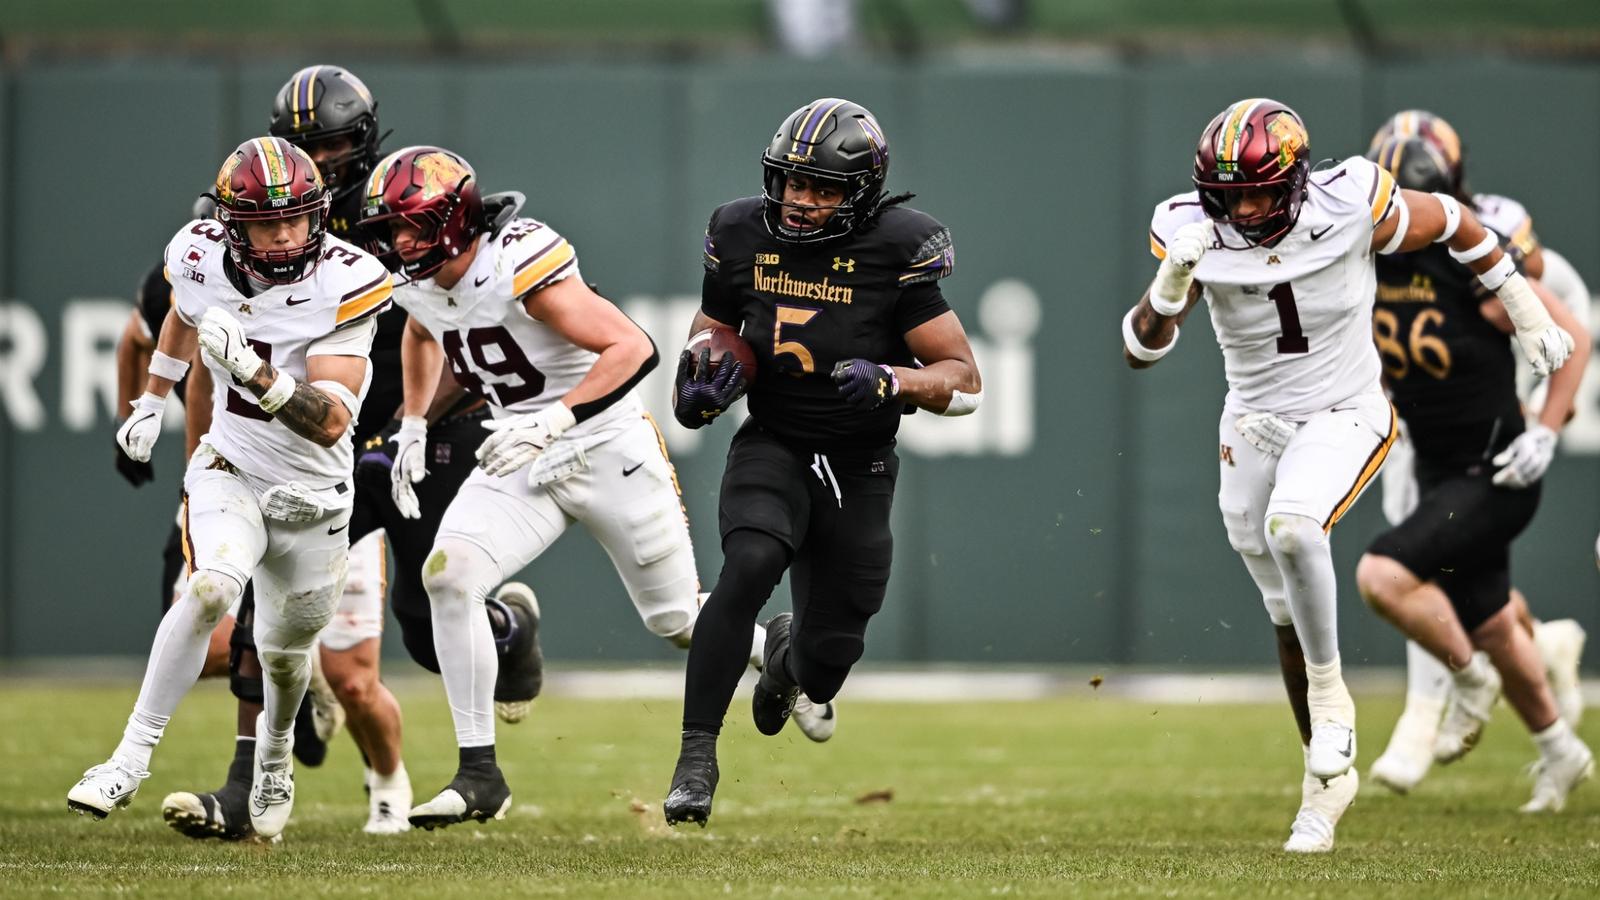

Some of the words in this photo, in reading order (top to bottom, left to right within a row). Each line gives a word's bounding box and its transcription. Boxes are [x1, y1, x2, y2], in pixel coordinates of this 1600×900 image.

[271, 198, 288, 208] ROW
[1218, 173, 1234, 182] ROW
[754, 265, 853, 304] Northwestern
[1267, 281, 1309, 354] 1
[443, 325, 546, 408] 49
[772, 303, 824, 374] 5
[1373, 307, 1452, 380] 86
